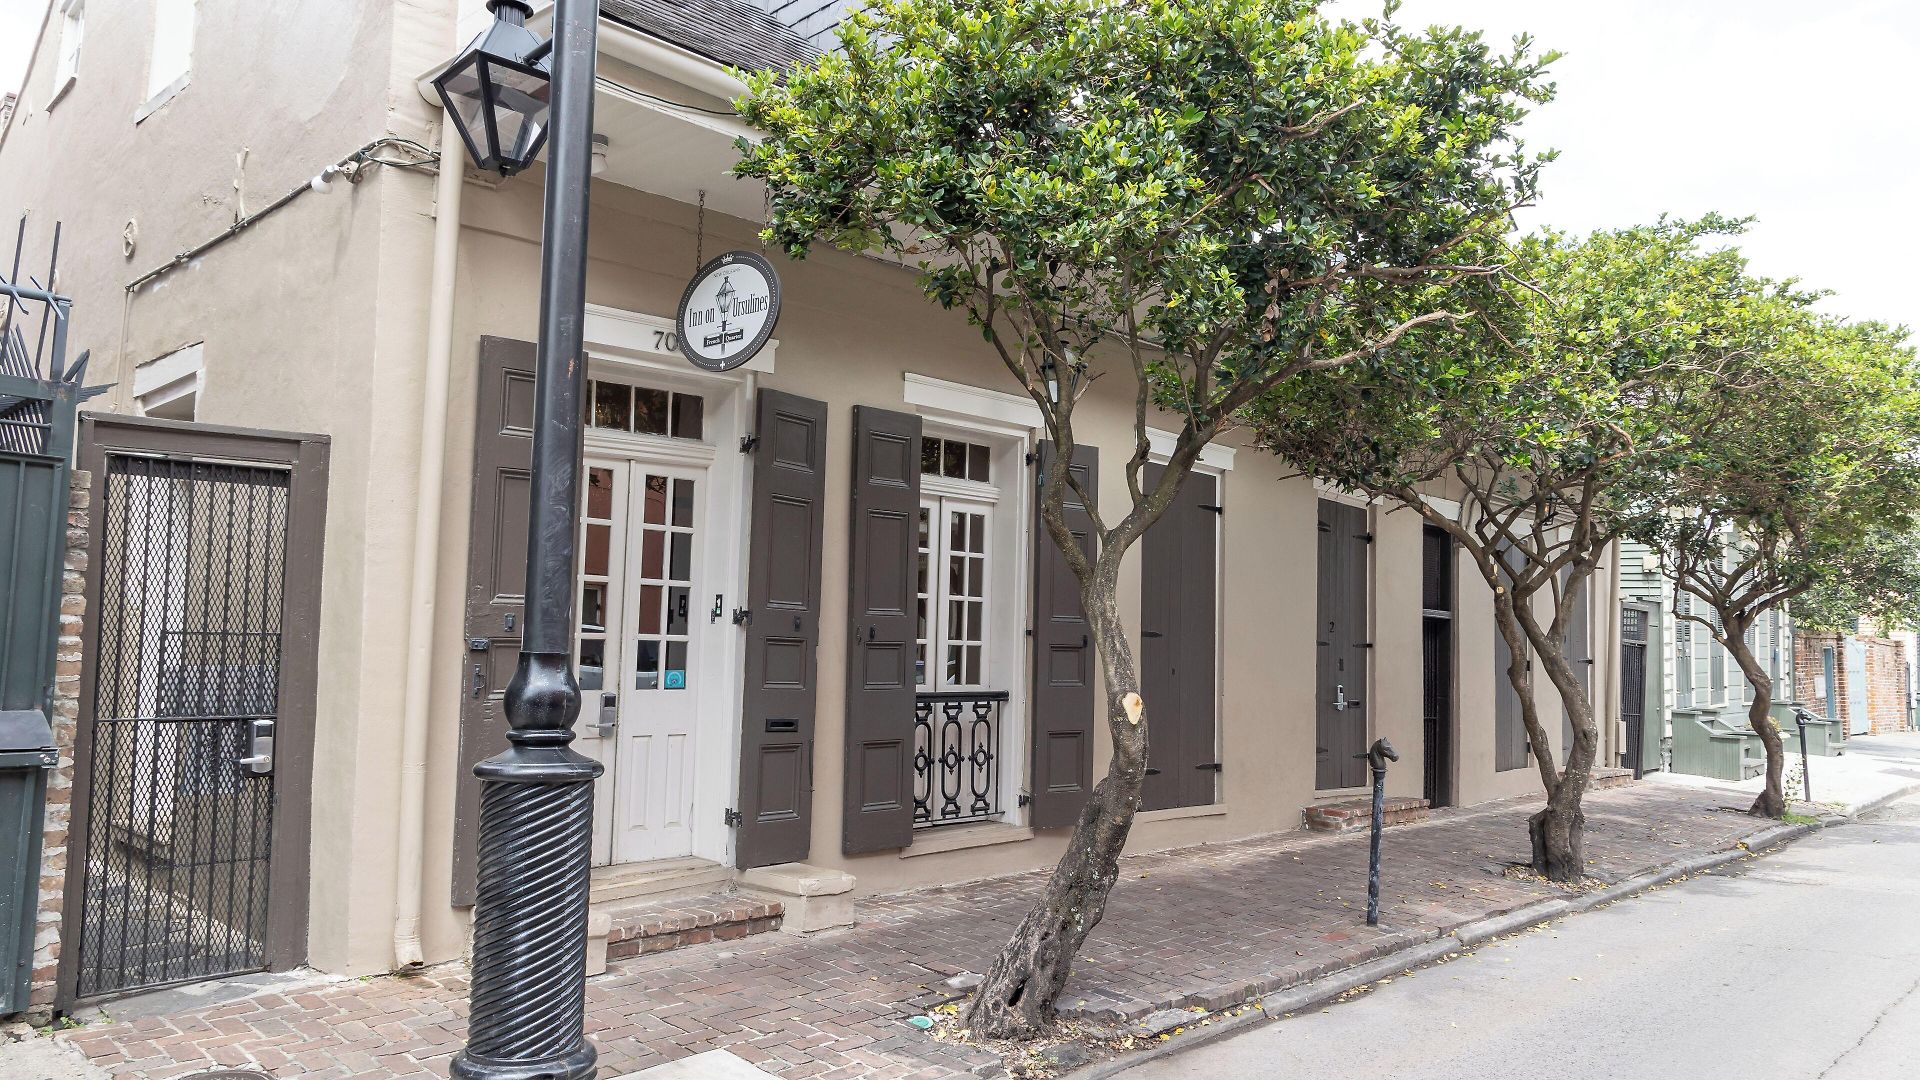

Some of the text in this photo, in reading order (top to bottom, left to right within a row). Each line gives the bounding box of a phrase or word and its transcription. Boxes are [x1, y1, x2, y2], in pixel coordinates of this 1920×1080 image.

[688, 293, 769, 328] Inn on Ursulines
[706, 334, 742, 346] French Quarter
